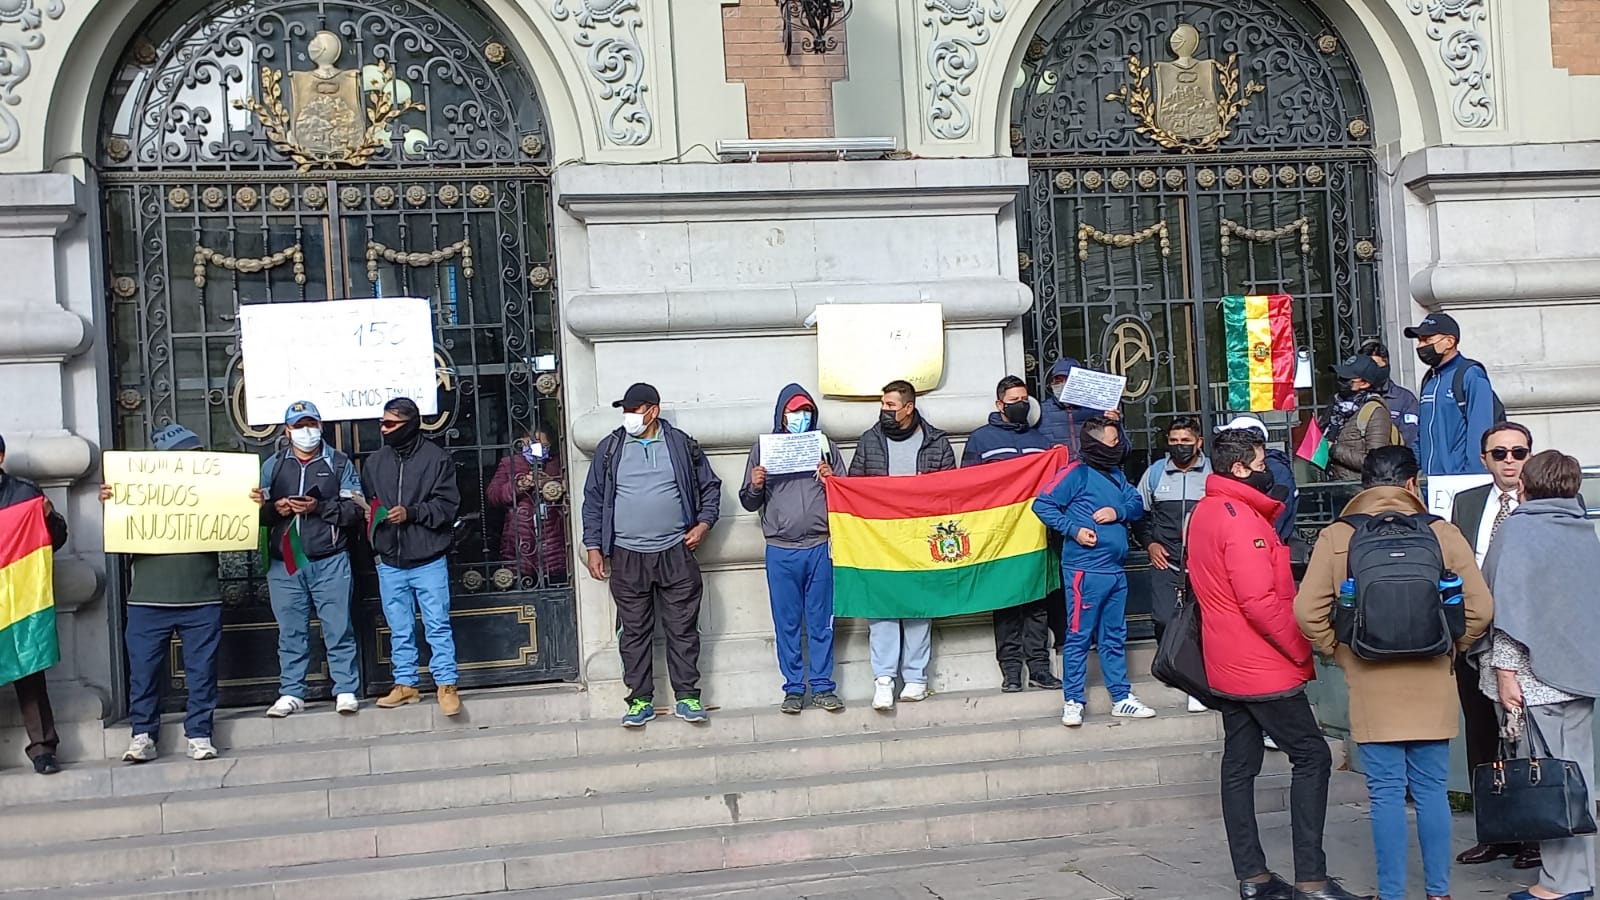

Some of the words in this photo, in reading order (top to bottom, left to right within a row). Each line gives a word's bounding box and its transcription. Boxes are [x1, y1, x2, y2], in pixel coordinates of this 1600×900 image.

[174, 457, 184, 474] A
[192, 457, 222, 476] LOS
[113, 482, 200, 507] DESPIDOS
[125, 512, 251, 542] INJUSTIFICADOS
